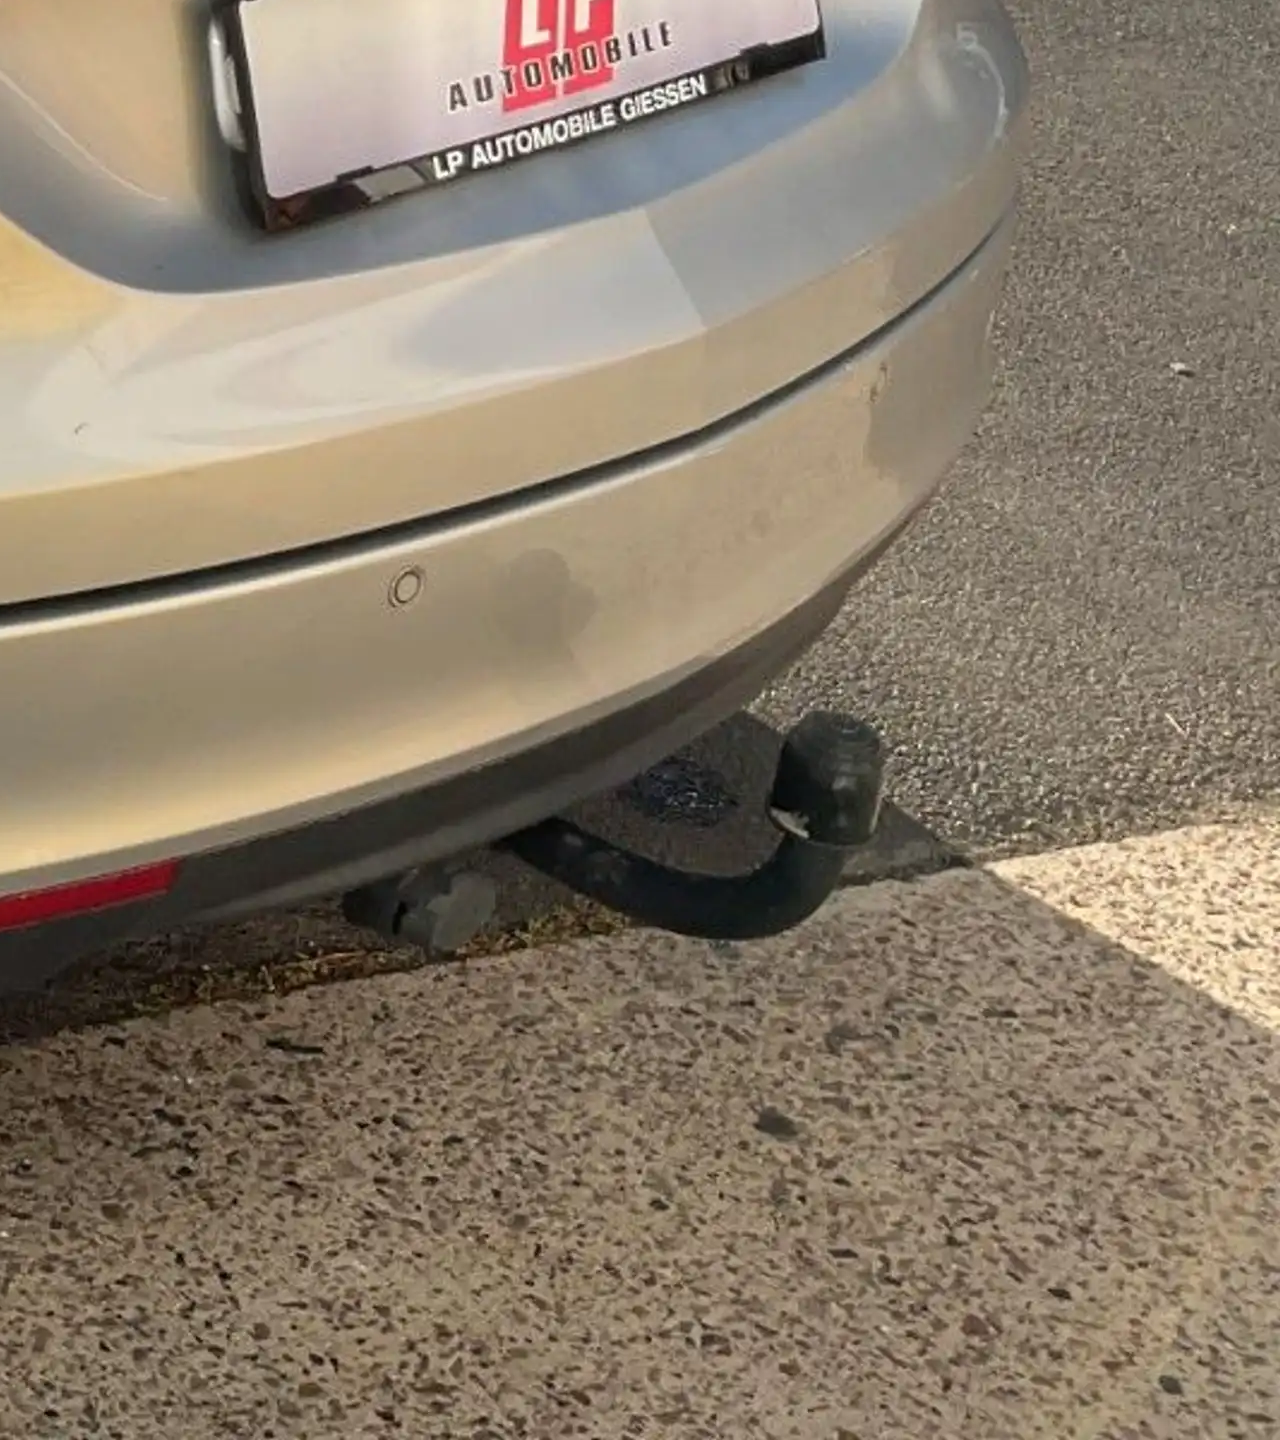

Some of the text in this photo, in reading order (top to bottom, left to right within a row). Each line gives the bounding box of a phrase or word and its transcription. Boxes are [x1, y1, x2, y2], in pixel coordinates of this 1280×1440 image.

[449, 21, 671, 111] AUTOMOBILE
[432, 73, 708, 180] LP AUTOMOBILE GIESSEN
